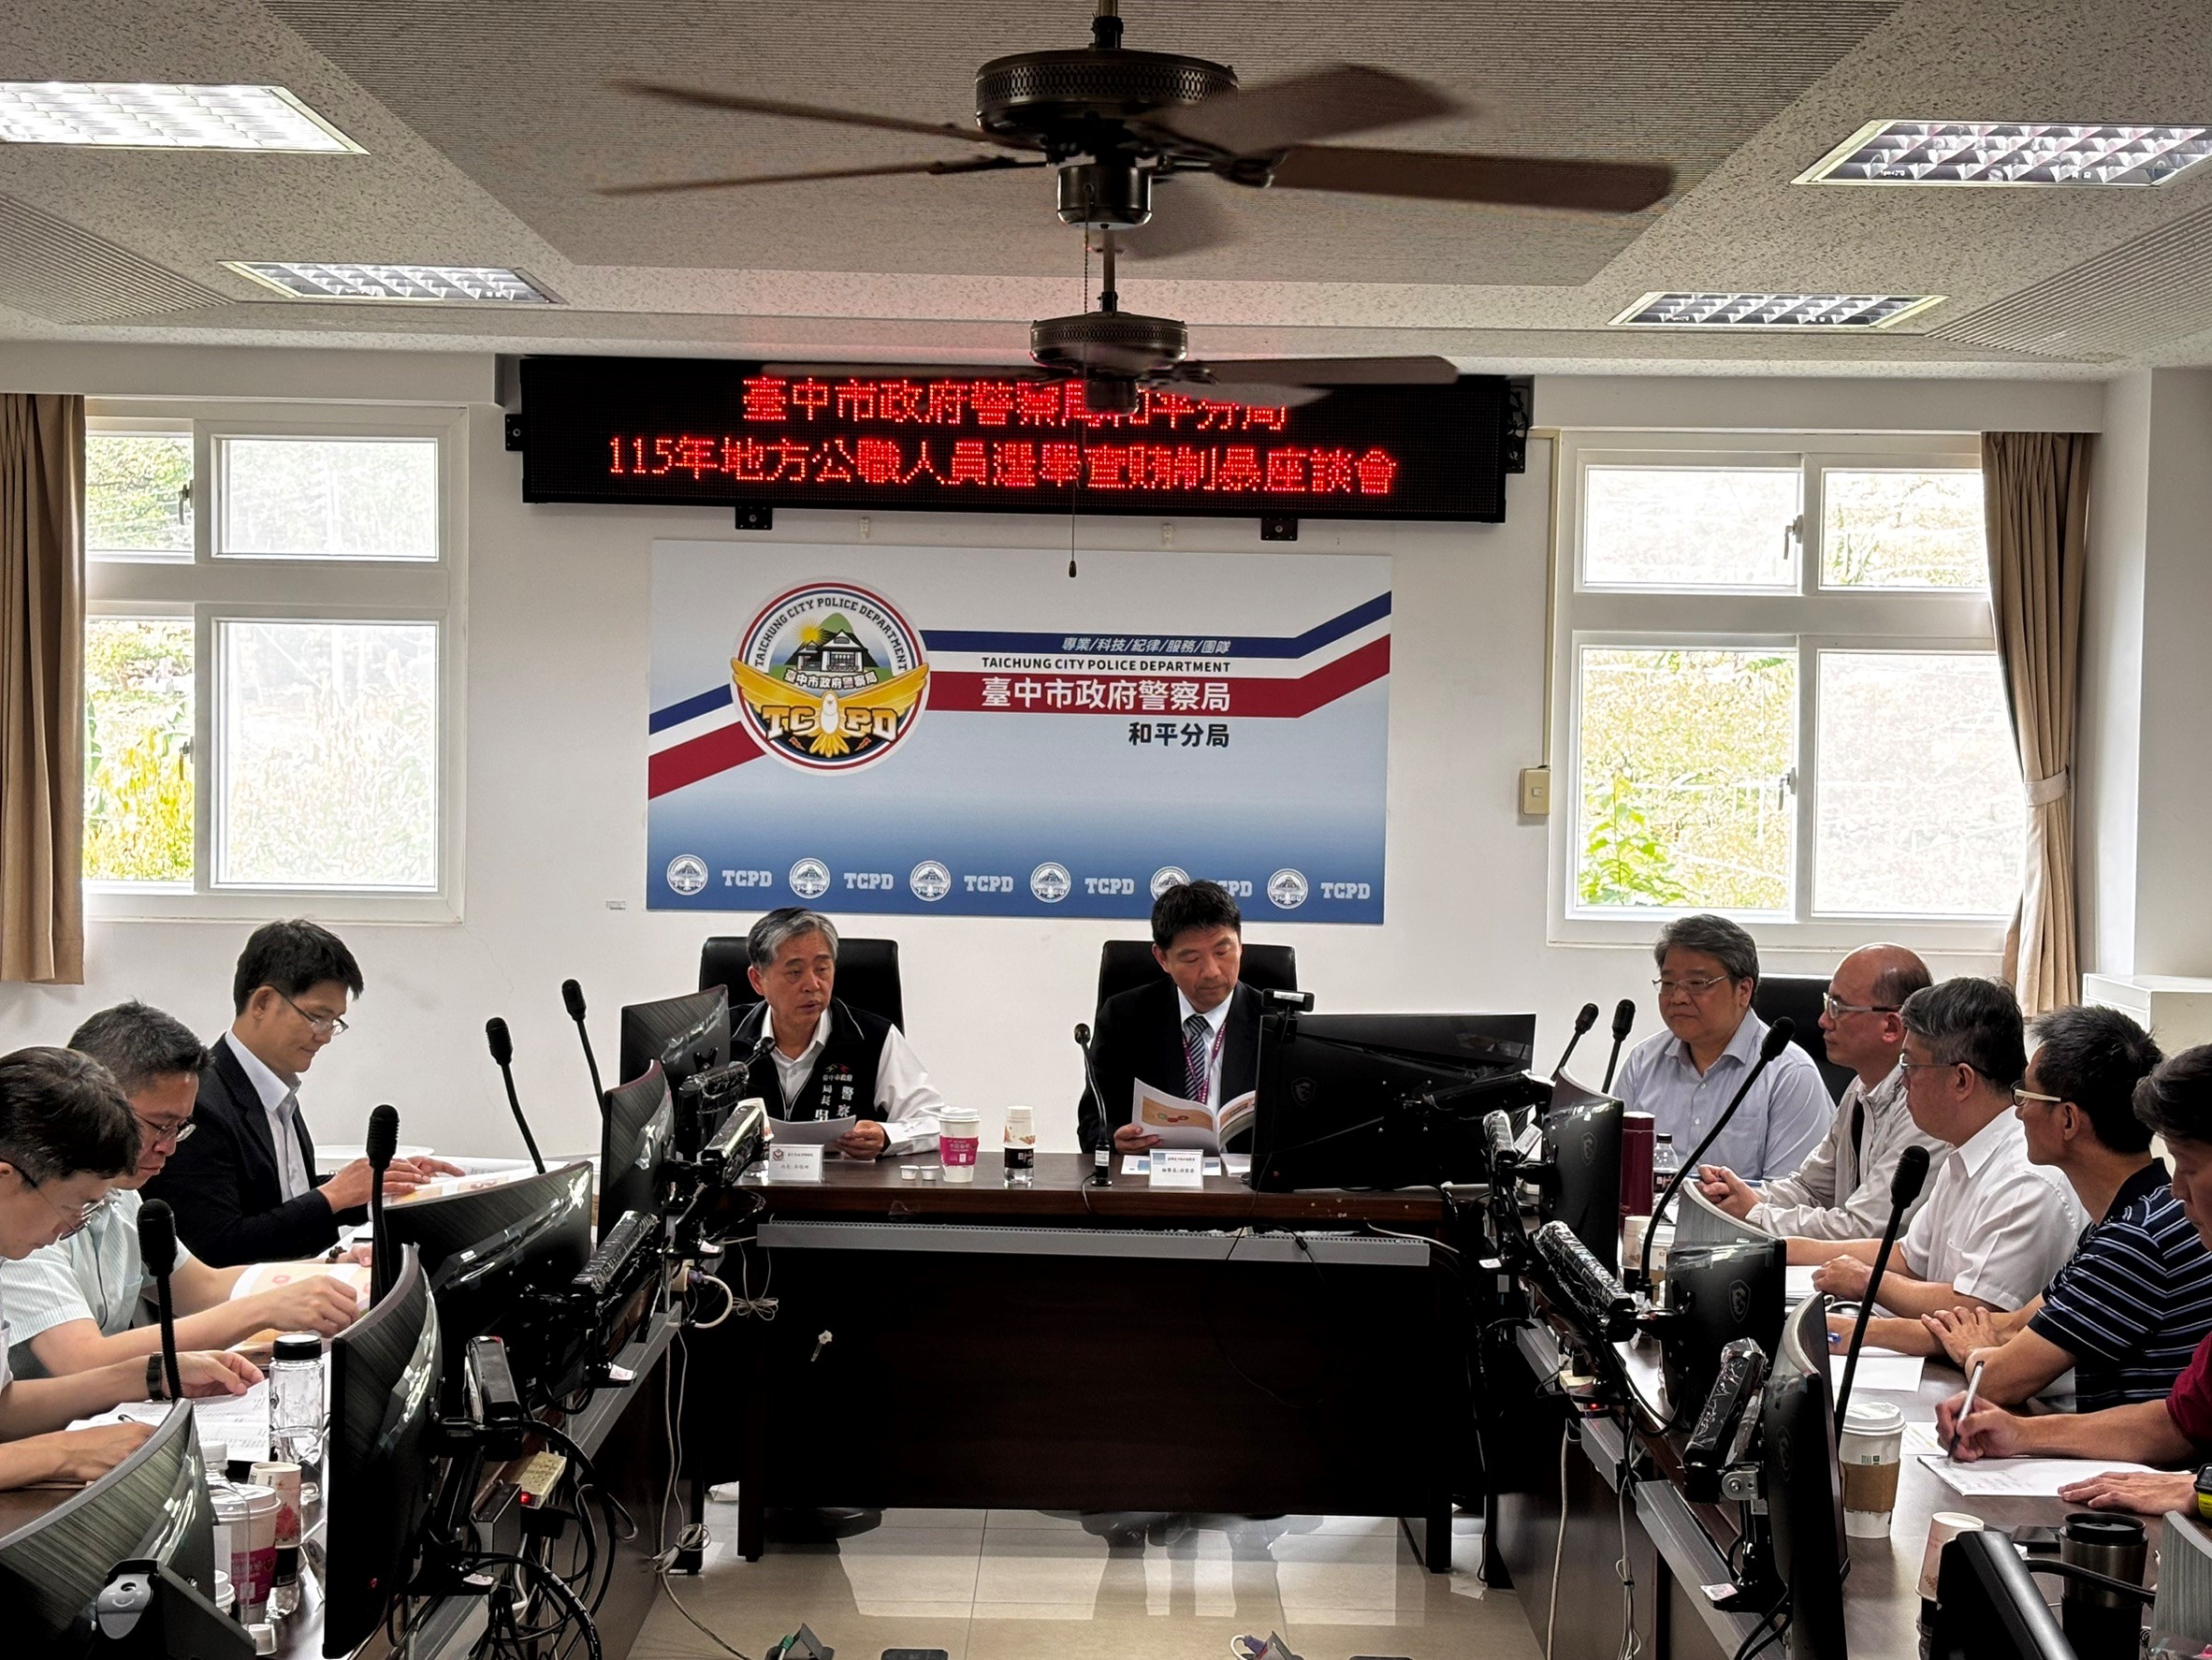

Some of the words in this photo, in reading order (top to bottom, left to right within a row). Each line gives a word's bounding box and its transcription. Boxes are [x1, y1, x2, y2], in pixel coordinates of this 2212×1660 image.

[754, 614, 789, 668] TAICHUNG
[788, 600, 815, 619] CITY
[817, 597, 858, 611] POLICE
[859, 605, 907, 670] DEPARTMENT
[1061, 636, 1231, 655] 專業/科技/紀律/服務/團隊
[982, 657, 1052, 669] TAICHUNG
[1055, 658, 1084, 670] CITY
[1087, 659, 1136, 671] POLICE
[1140, 660, 1231, 673] DEPARTMENT
[783, 668, 879, 690] 臺中市政府警察局
[981, 677, 1231, 712] 臺中市政府警察局
[1128, 721, 1230, 749] 和平分局
[721, 869, 773, 887] TCPD
[843, 872, 895, 890] TCPD
[964, 875, 1014, 893] TCPD
[1084, 877, 1135, 896] TCPD
[1320, 882, 1371, 899] TCPD
